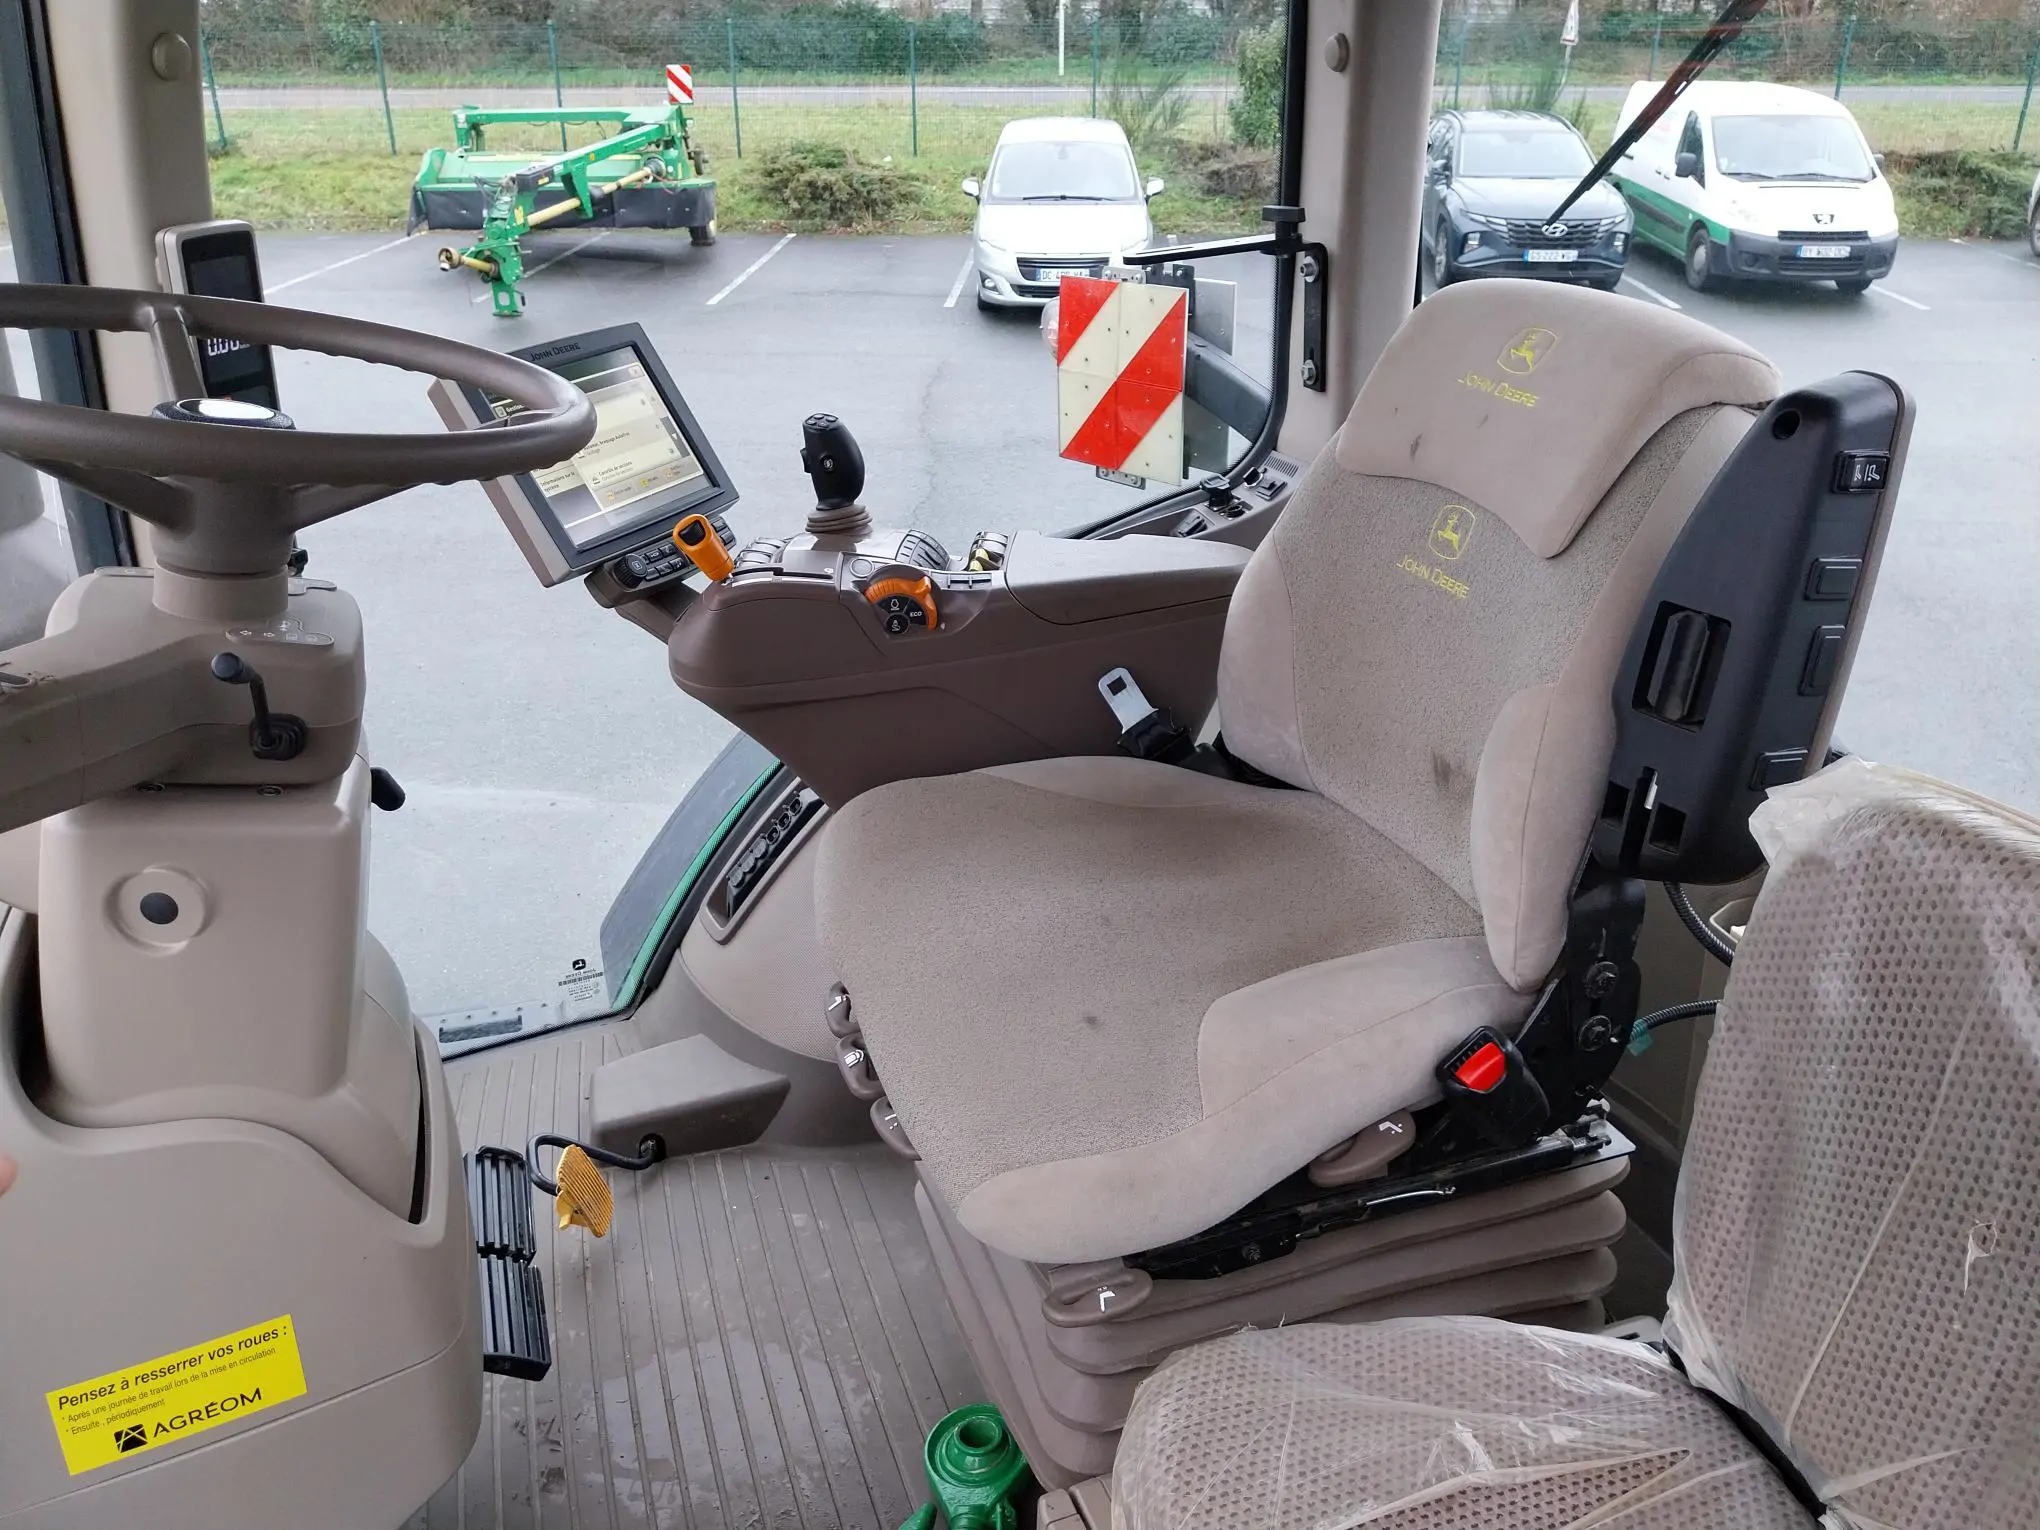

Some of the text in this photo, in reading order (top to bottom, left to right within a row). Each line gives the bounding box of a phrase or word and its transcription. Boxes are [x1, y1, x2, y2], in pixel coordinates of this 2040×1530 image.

[530, 342, 581, 361] JOHN DEERE
[1457, 371, 1540, 408] JOHN DEERE
[1396, 554, 1470, 599] JOHN DEERE
[909, 610, 923, 618] ECO
[58, 1383, 116, 1410] Pensez
[120, 1376, 130, 1391] à
[135, 1354, 205, 1386] resserrer
[208, 1344, 234, 1361] vos
[238, 1327, 279, 1351] roues
[68, 1347, 276, 1423] Après une journée de travail lors de la mise en circulation
[71, 1420, 100, 1435] Ensuite
[106, 1398, 165, 1424] périodiquement
[153, 1387, 263, 1438] AGRÉOM
